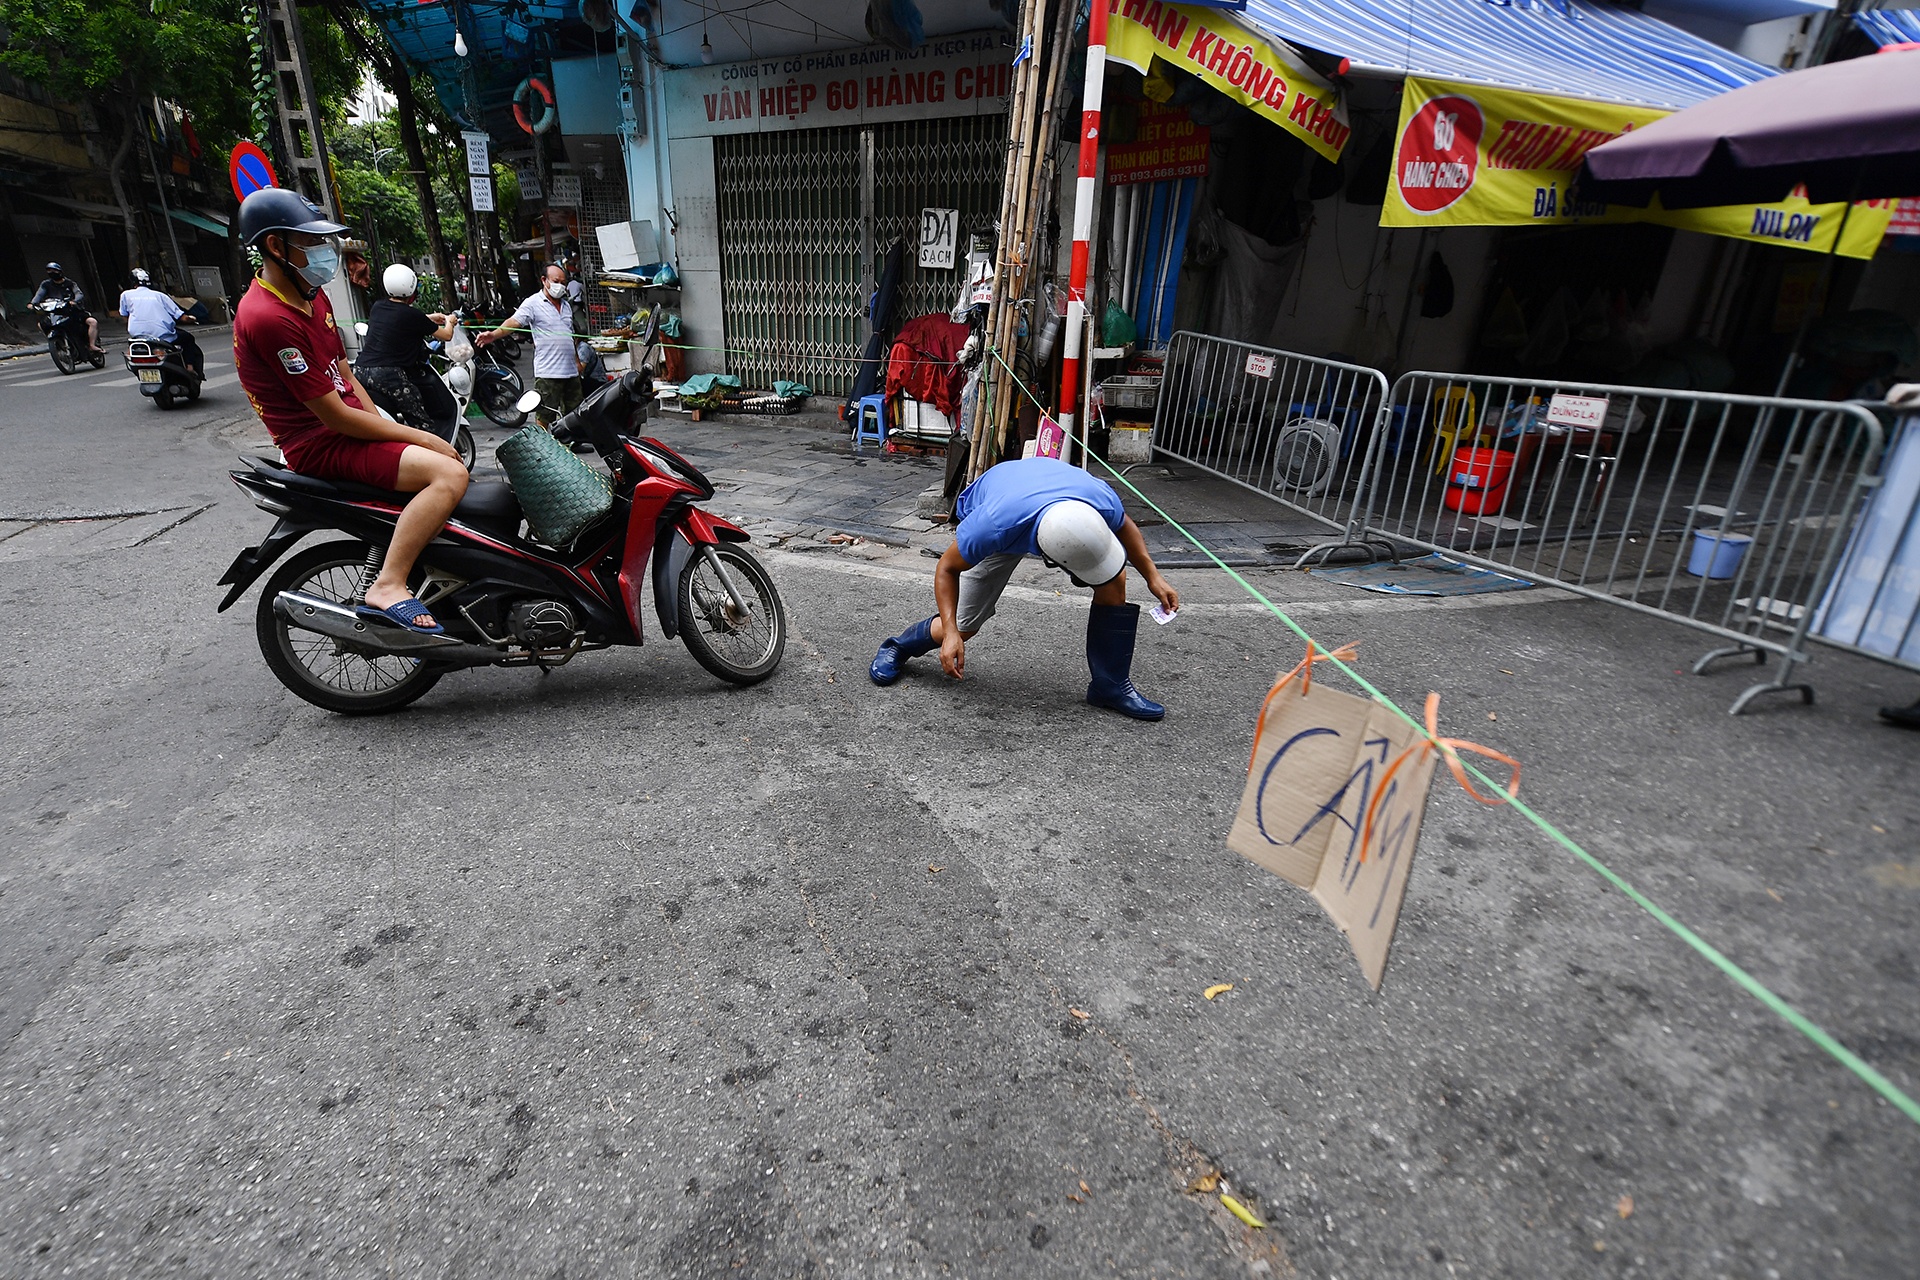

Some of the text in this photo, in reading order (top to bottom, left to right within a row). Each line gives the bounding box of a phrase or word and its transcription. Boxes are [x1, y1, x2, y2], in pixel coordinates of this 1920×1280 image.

[721, 64, 758, 81] CÔNG
[761, 60, 779, 77] TY
[783, 55, 802, 74] CỔ
[806, 51, 845, 73] PHẦN
[850, 47, 890, 66] BÁNH
[934, 39, 966, 58] KẸO
[971, 32, 994, 53] HÀ
[1187, 26, 1288, 111] KHÔNG
[704, 85, 751, 122] VÂN
[760, 78, 817, 121] HIỆP
[826, 80, 859, 112] 60
[866, 67, 945, 109] HÀNG
[1166, 119, 1196, 139] CAO
[1434, 110, 1459, 151] 60
[1487, 119, 1574, 170] THAN
[1109, 152, 1136, 170] THAN
[1138, 146, 1160, 167] KHÔ
[1179, 140, 1208, 162] CHÁY
[1402, 155, 1469, 189] HÀNG CHIẾU
[1109, 163, 1206, 184] ĐT: 093.668.9310
[1533, 182, 1557, 218] ĐÁ
[922, 209, 955, 247] ĐÁ
[1751, 207, 1821, 243] NILON
[921, 249, 952, 265] SẠCH
[1250, 362, 1267, 373] STOP
